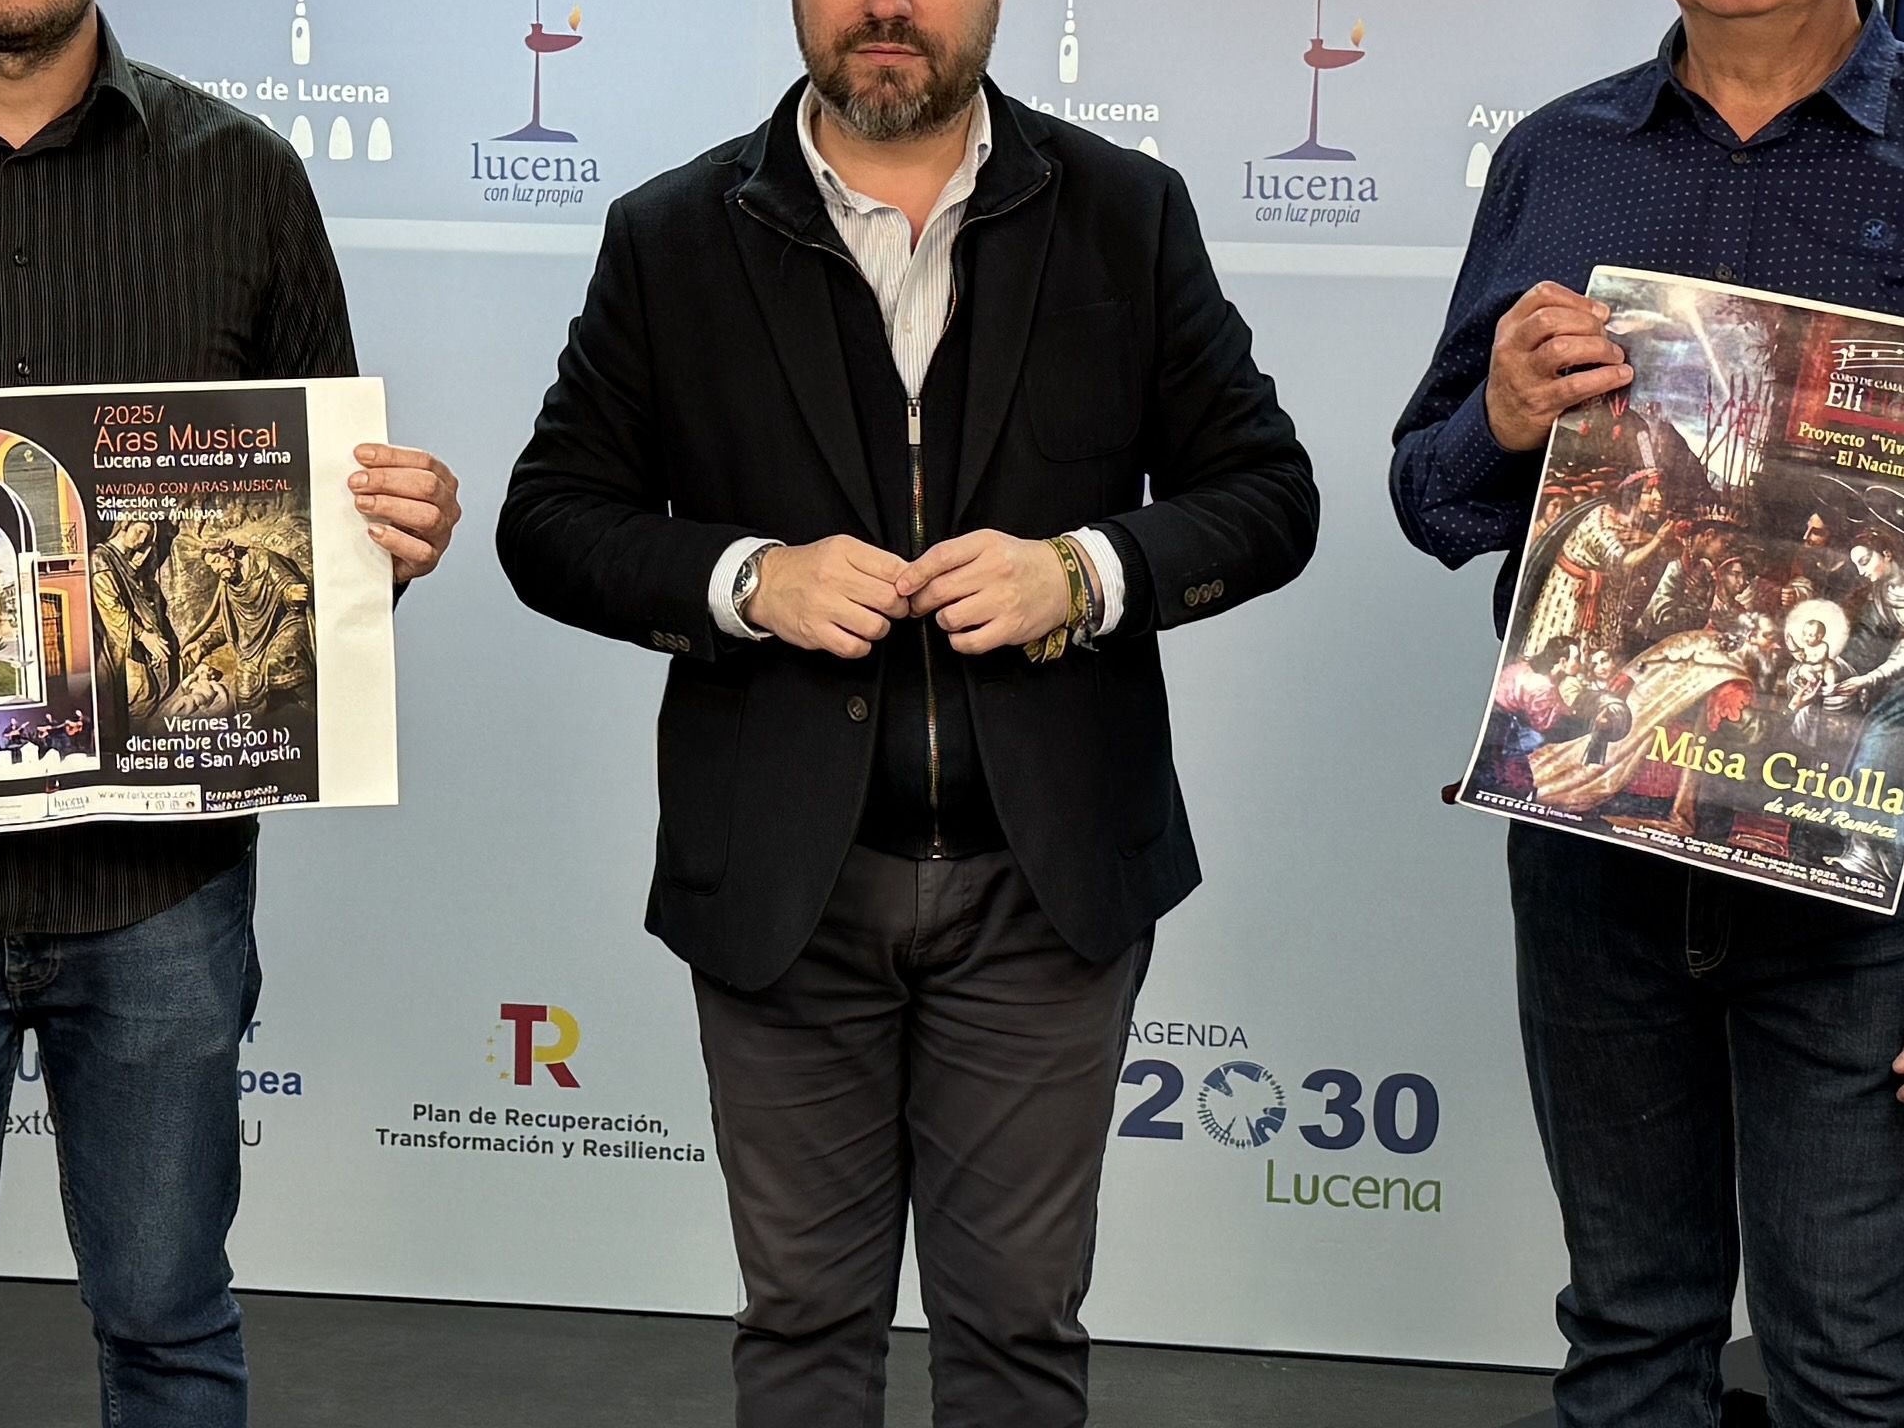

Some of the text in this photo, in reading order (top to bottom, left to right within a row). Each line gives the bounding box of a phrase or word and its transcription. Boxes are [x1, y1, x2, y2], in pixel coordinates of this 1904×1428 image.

[256, 76, 289, 101] de
[298, 78, 390, 103] Lucena
[1064, 98, 1160, 122] Lucena
[471, 142, 600, 183] lucena
[1242, 161, 1379, 202] lucena
[484, 184, 584, 208] con luz propia
[1255, 204, 1360, 228] con luz propia
[1830, 372, 1858, 385] CORO
[1860, 377, 1873, 387] DE
[1825, 381, 1865, 412] Elí
[94, 405, 164, 424] /2025/
[95, 421, 278, 452] Aras Musical
[1798, 421, 1866, 449] Proyecto
[94, 449, 291, 468] Lucena en cuerda y alma
[1830, 450, 1853, 467] -El
[96, 478, 292, 495] NAVIDAD CON ARAS MUSICAL
[96, 495, 177, 508] Selección de
[97, 508, 165, 521] Villancicos
[164, 713, 252, 732] Viernes 12
[126, 727, 290, 752] diciembre (19:00 h)
[116, 745, 300, 773] Iglesia de San Agustín
[1646, 725, 1904, 815] Misa Criolla
[1763, 796, 1784, 814] de
[1785, 800, 1834, 824] Ariel
[1128, 1020, 1248, 1049] AGENDA
[413, 1104, 669, 1137] Plan de Recuperación,
[376, 1128, 705, 1163] Transformación y Resiliencia
[1266, 1159, 1441, 1213] Lucena
